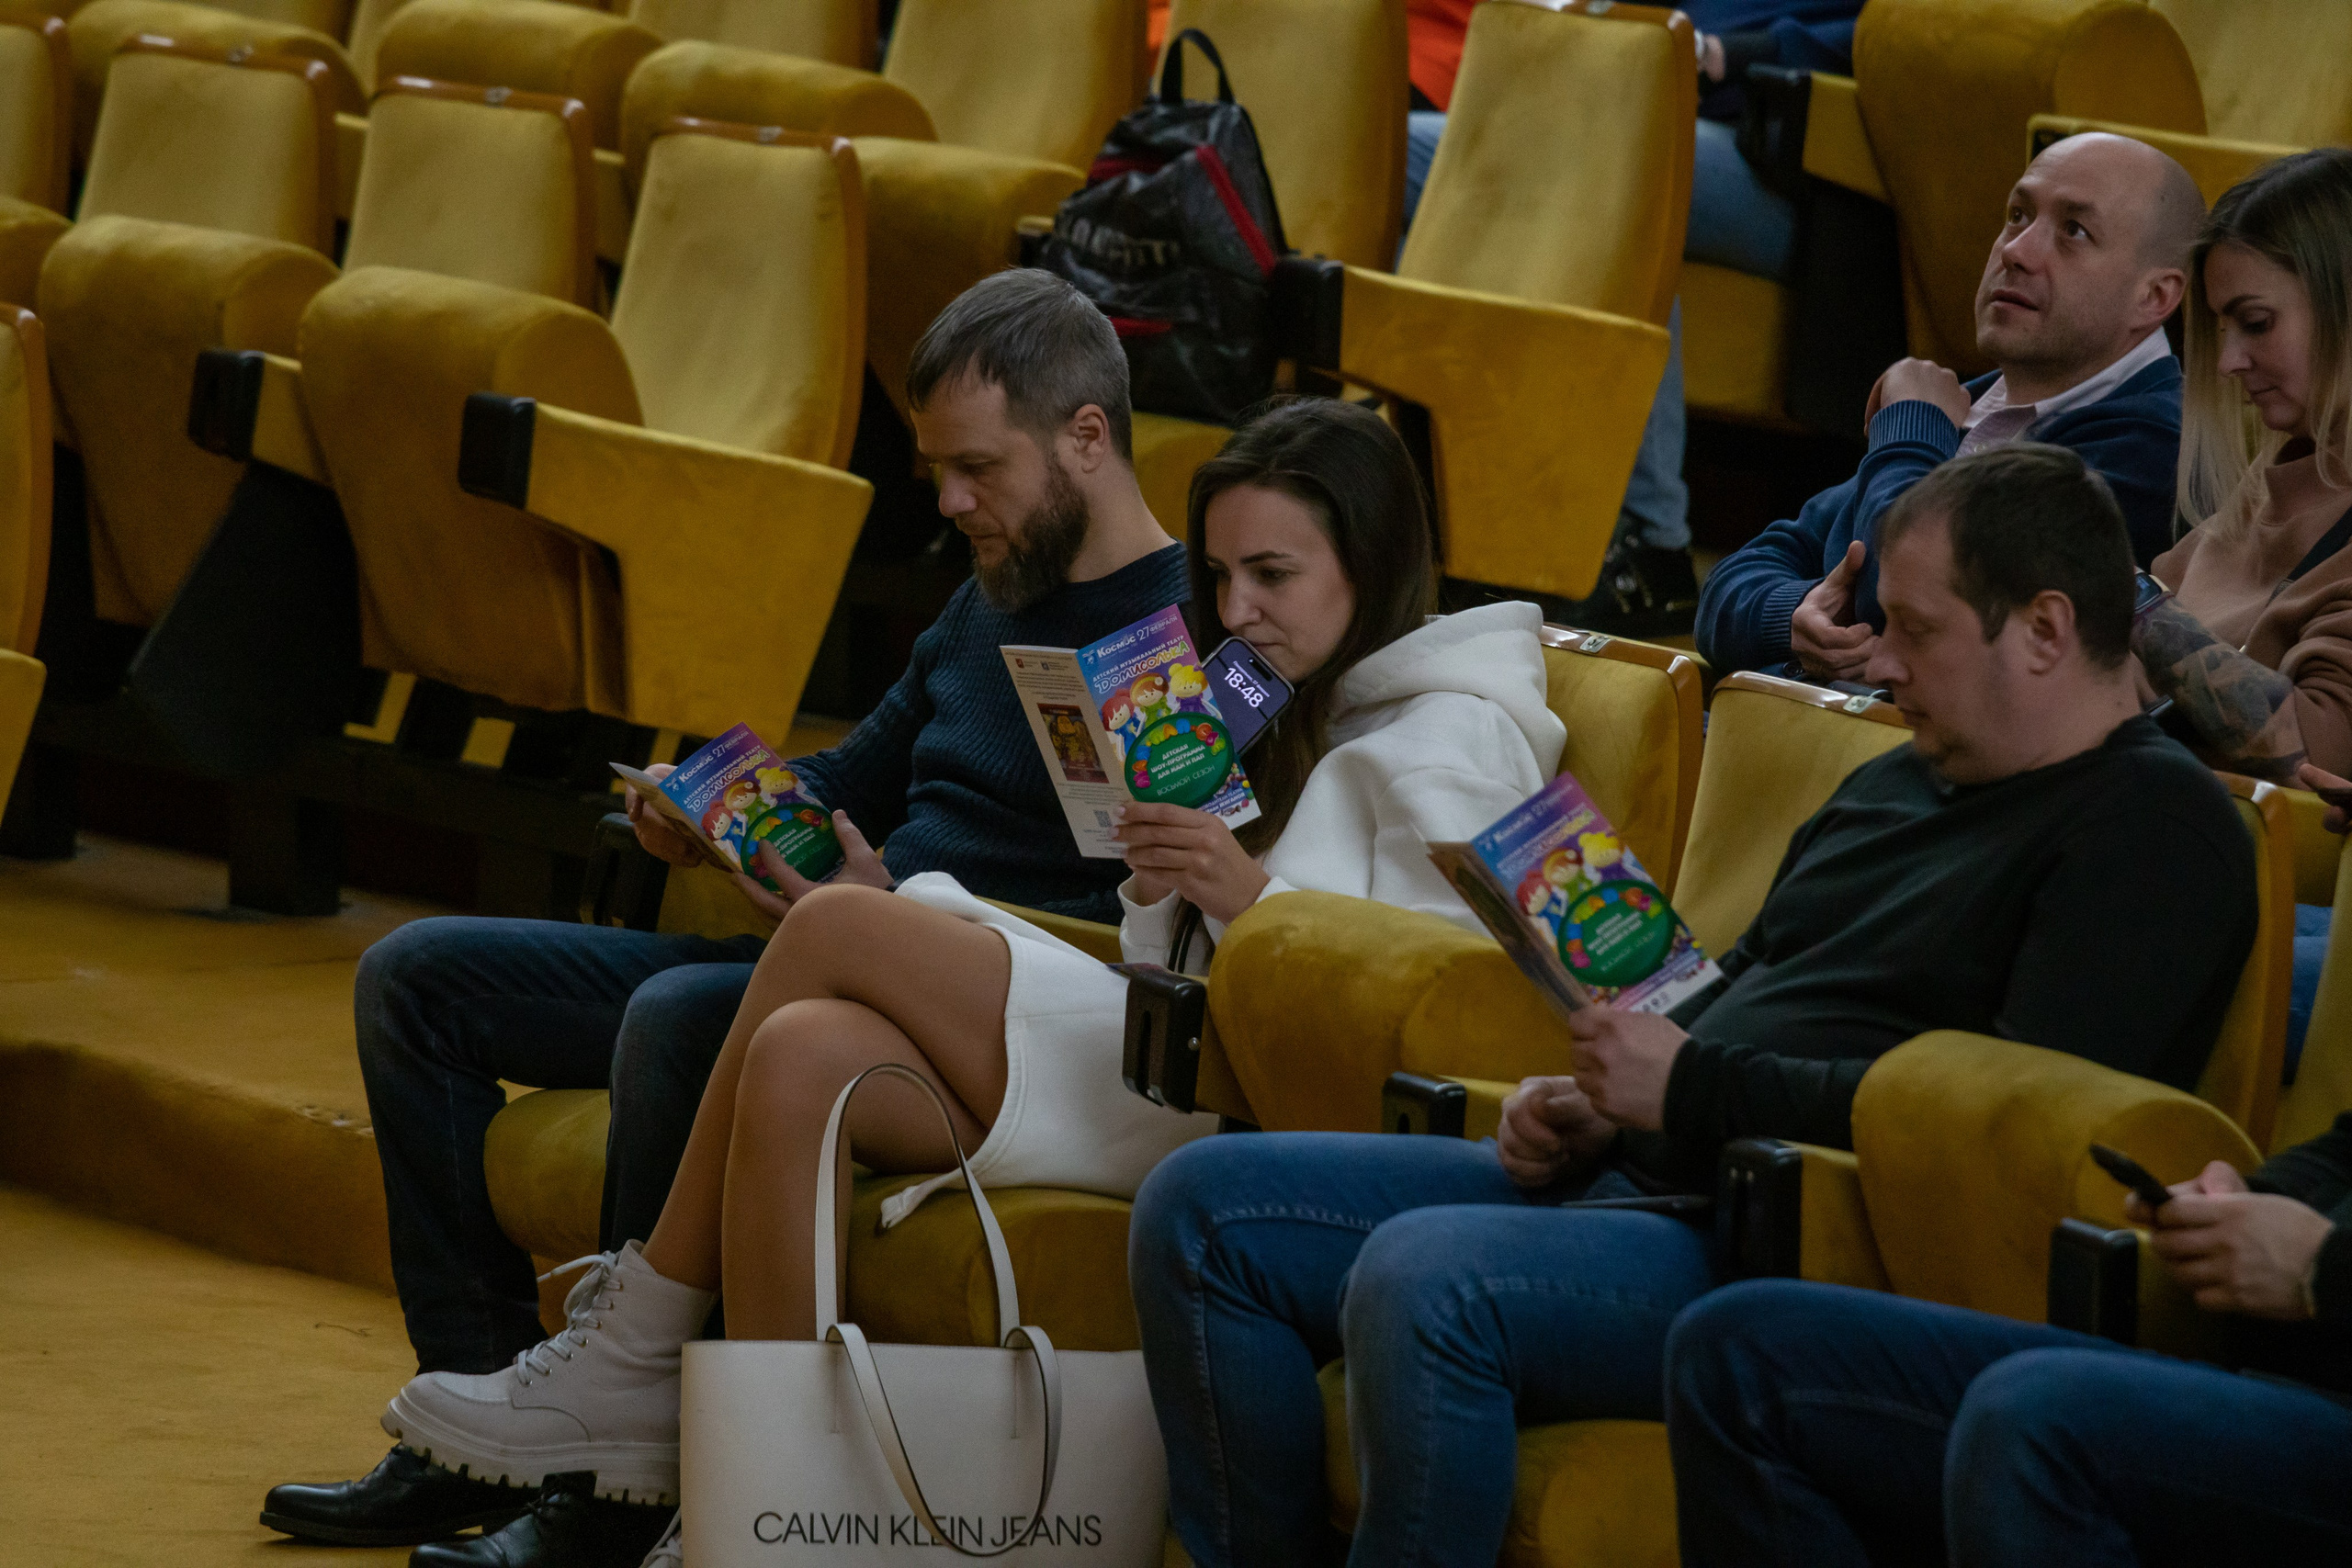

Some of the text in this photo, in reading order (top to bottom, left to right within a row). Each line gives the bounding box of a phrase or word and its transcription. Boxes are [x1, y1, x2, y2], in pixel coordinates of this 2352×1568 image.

[1136, 626, 1151, 640] 27
[1149, 616, 1177, 632] ФЕВРАЛЯ
[1093, 665, 1119, 681] ДЕТСКИЙ
[1119, 643, 1166, 667] МУЗЫКАЛЬНЫЙ
[1168, 636, 1184, 646] ТЕАТР
[1225, 668, 1263, 707] 18:48
[713, 744, 726, 758] 27
[1150, 745, 1205, 773] ШОУ-ПРОГРАММА
[1161, 744, 1189, 761] ДЕТСКАЯ
[1156, 769, 1170, 779] ДЛЯ
[1170, 761, 1185, 773] МАМ
[1190, 752, 1205, 762] ПАП
[1157, 764, 1215, 795] ВОСЬМОЙ СЕЗОН
[753, 1511, 1102, 1547] CALVIN KLEIN JEANS
